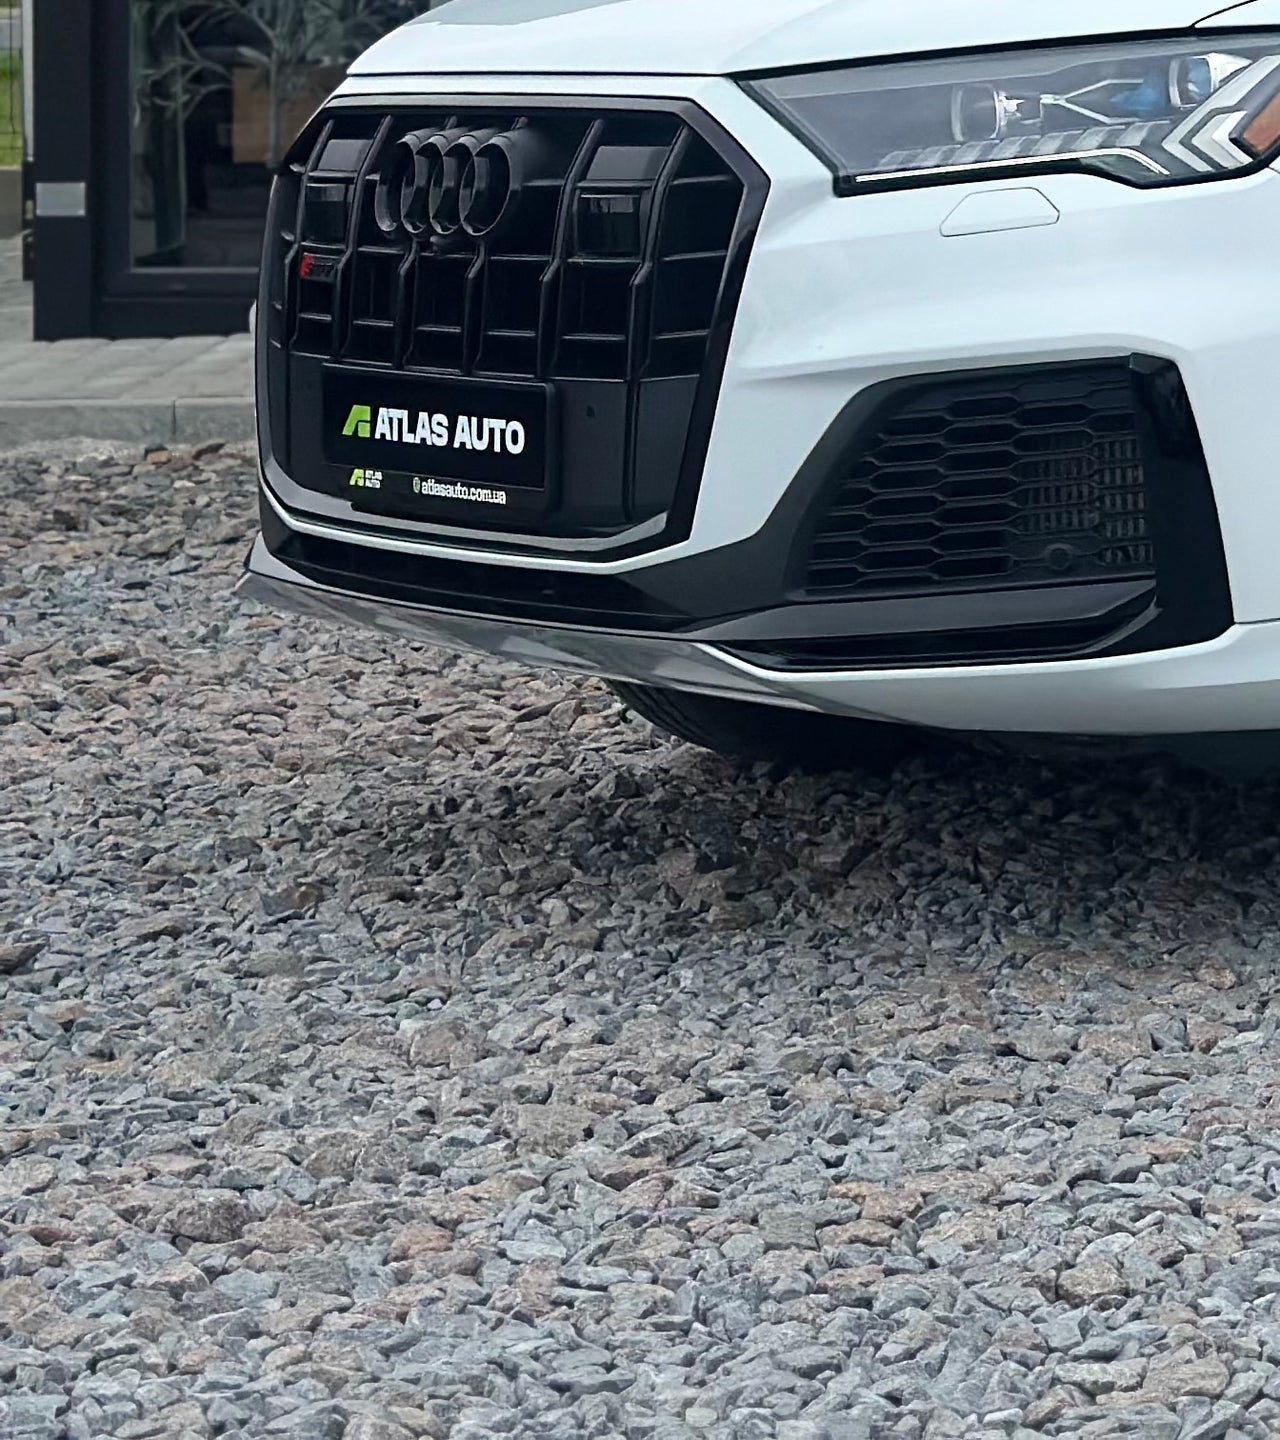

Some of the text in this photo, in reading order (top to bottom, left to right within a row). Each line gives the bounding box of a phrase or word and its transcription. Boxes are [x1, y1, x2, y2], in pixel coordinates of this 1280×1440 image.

[374, 406, 526, 455] ATLAS AUTO
[421, 477, 507, 506] atlasauto.com.ua
